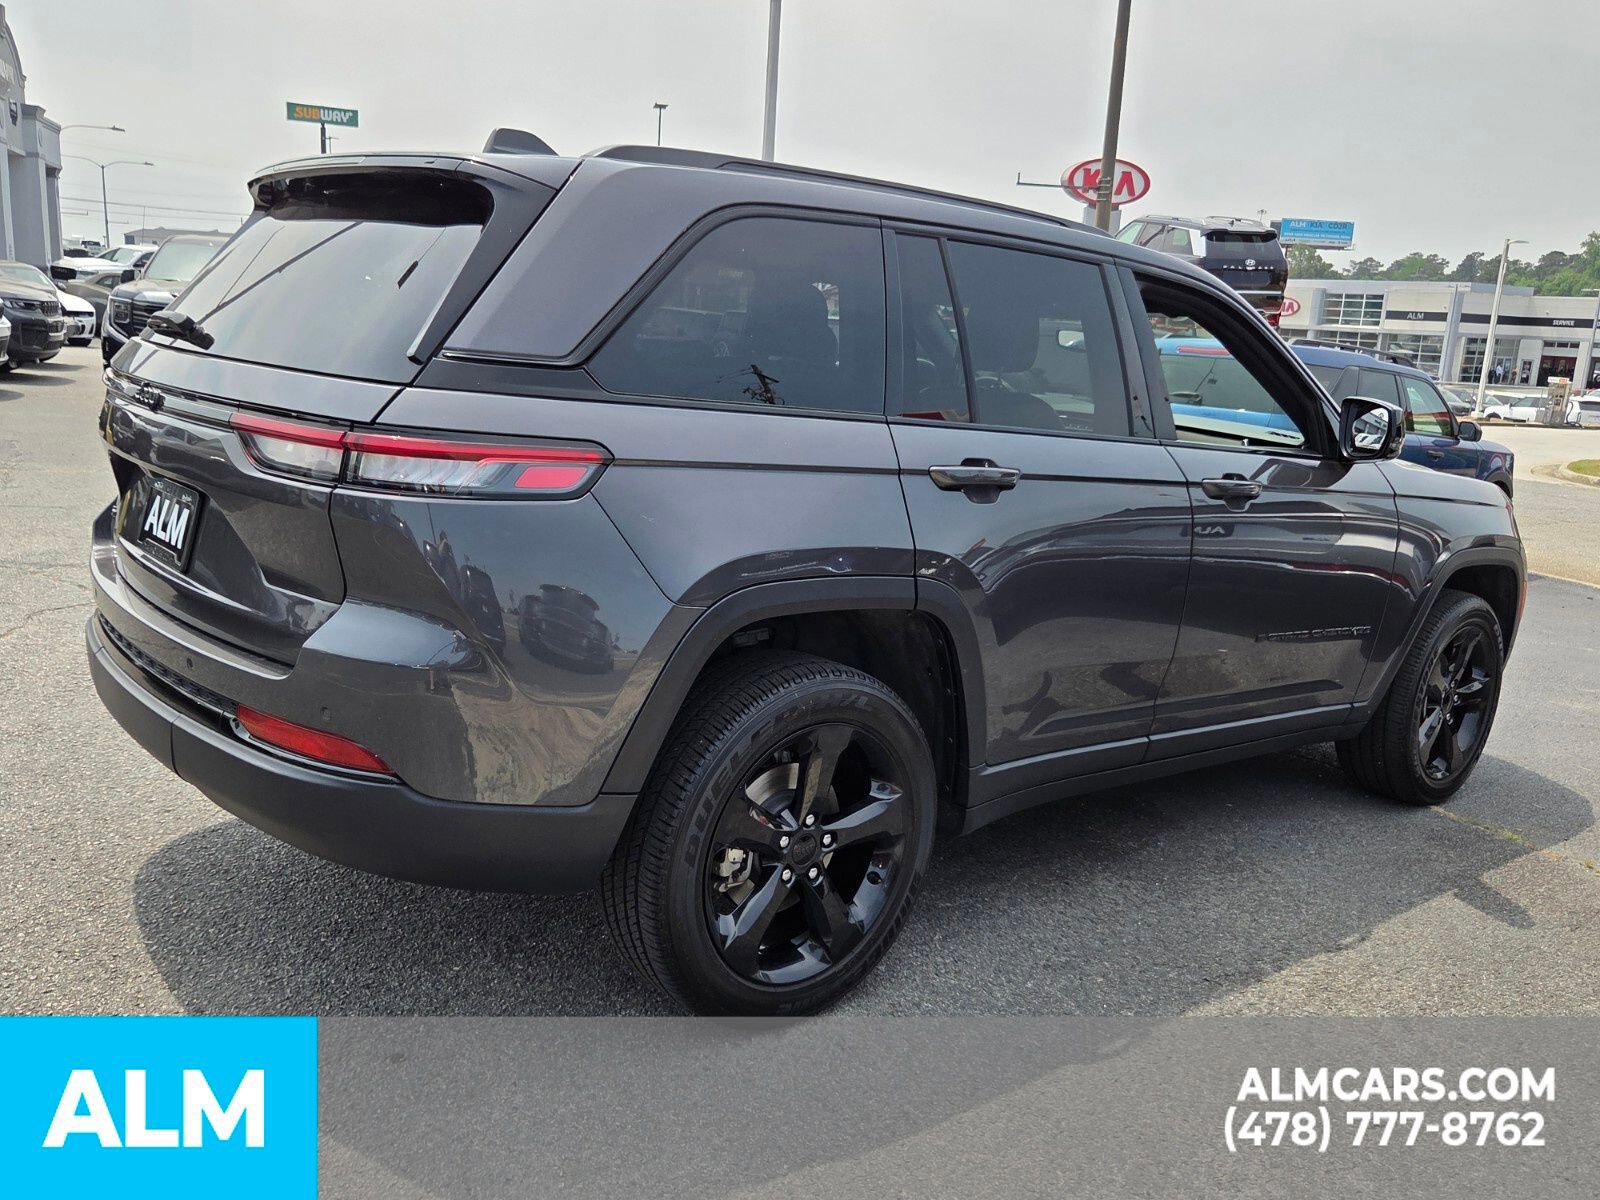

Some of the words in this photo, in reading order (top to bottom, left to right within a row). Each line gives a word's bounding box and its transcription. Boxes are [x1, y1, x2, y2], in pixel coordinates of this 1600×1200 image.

[295, 106, 351, 122] SUBWAY
[1083, 168, 1135, 196] KA
[144, 495, 190, 549] ALM
